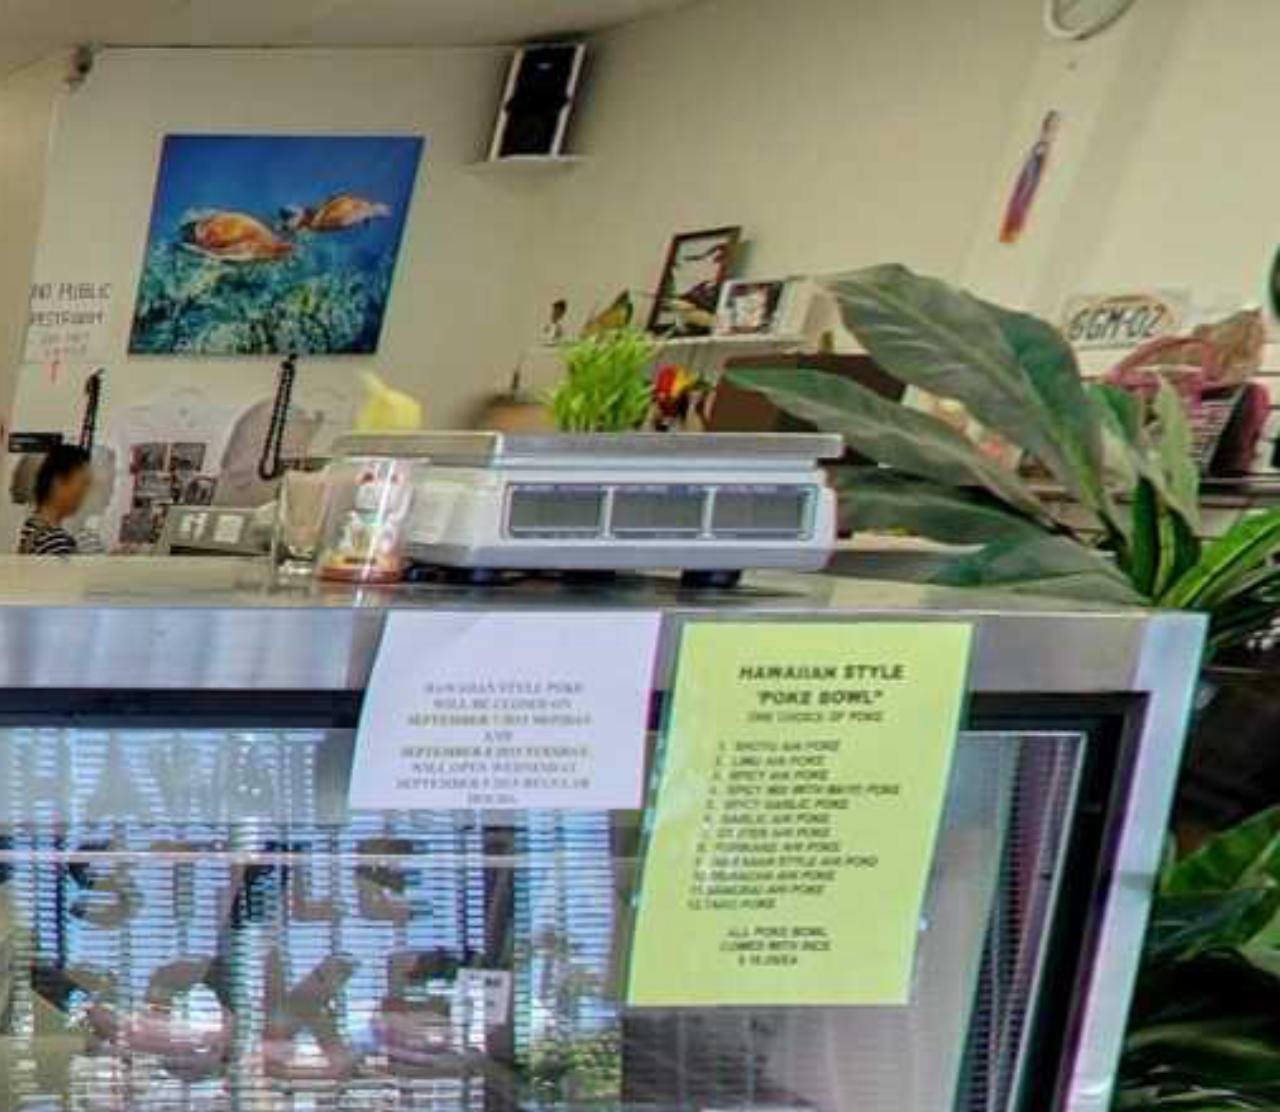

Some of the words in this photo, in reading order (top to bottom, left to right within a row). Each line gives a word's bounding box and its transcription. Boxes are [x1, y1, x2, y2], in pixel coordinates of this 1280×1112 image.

[58, 283, 111, 300] PUBLIC
[738, 665, 837, 680] HAWAIIAN
[843, 665, 905, 680] STYLE
[849, 711, 883, 722] POKE
[483, 730, 513, 742] AND
[806, 741, 840, 751] POKE
[789, 755, 827, 766] POKE
[794, 770, 829, 780] POKE
[866, 785, 899, 795] POKE
[815, 799, 849, 810] POKE
[797, 814, 829, 824] POKE
[797, 828, 831, 838] POKE
[807, 842, 840, 852] POKE
[845, 856, 879, 867] POKE
[802, 870, 835, 880] POKE
[792, 885, 825, 895] POKE
[740, 899, 776, 909] POKE
[754, 926, 789, 937] POKE
[802, 941, 832, 951] RICE
